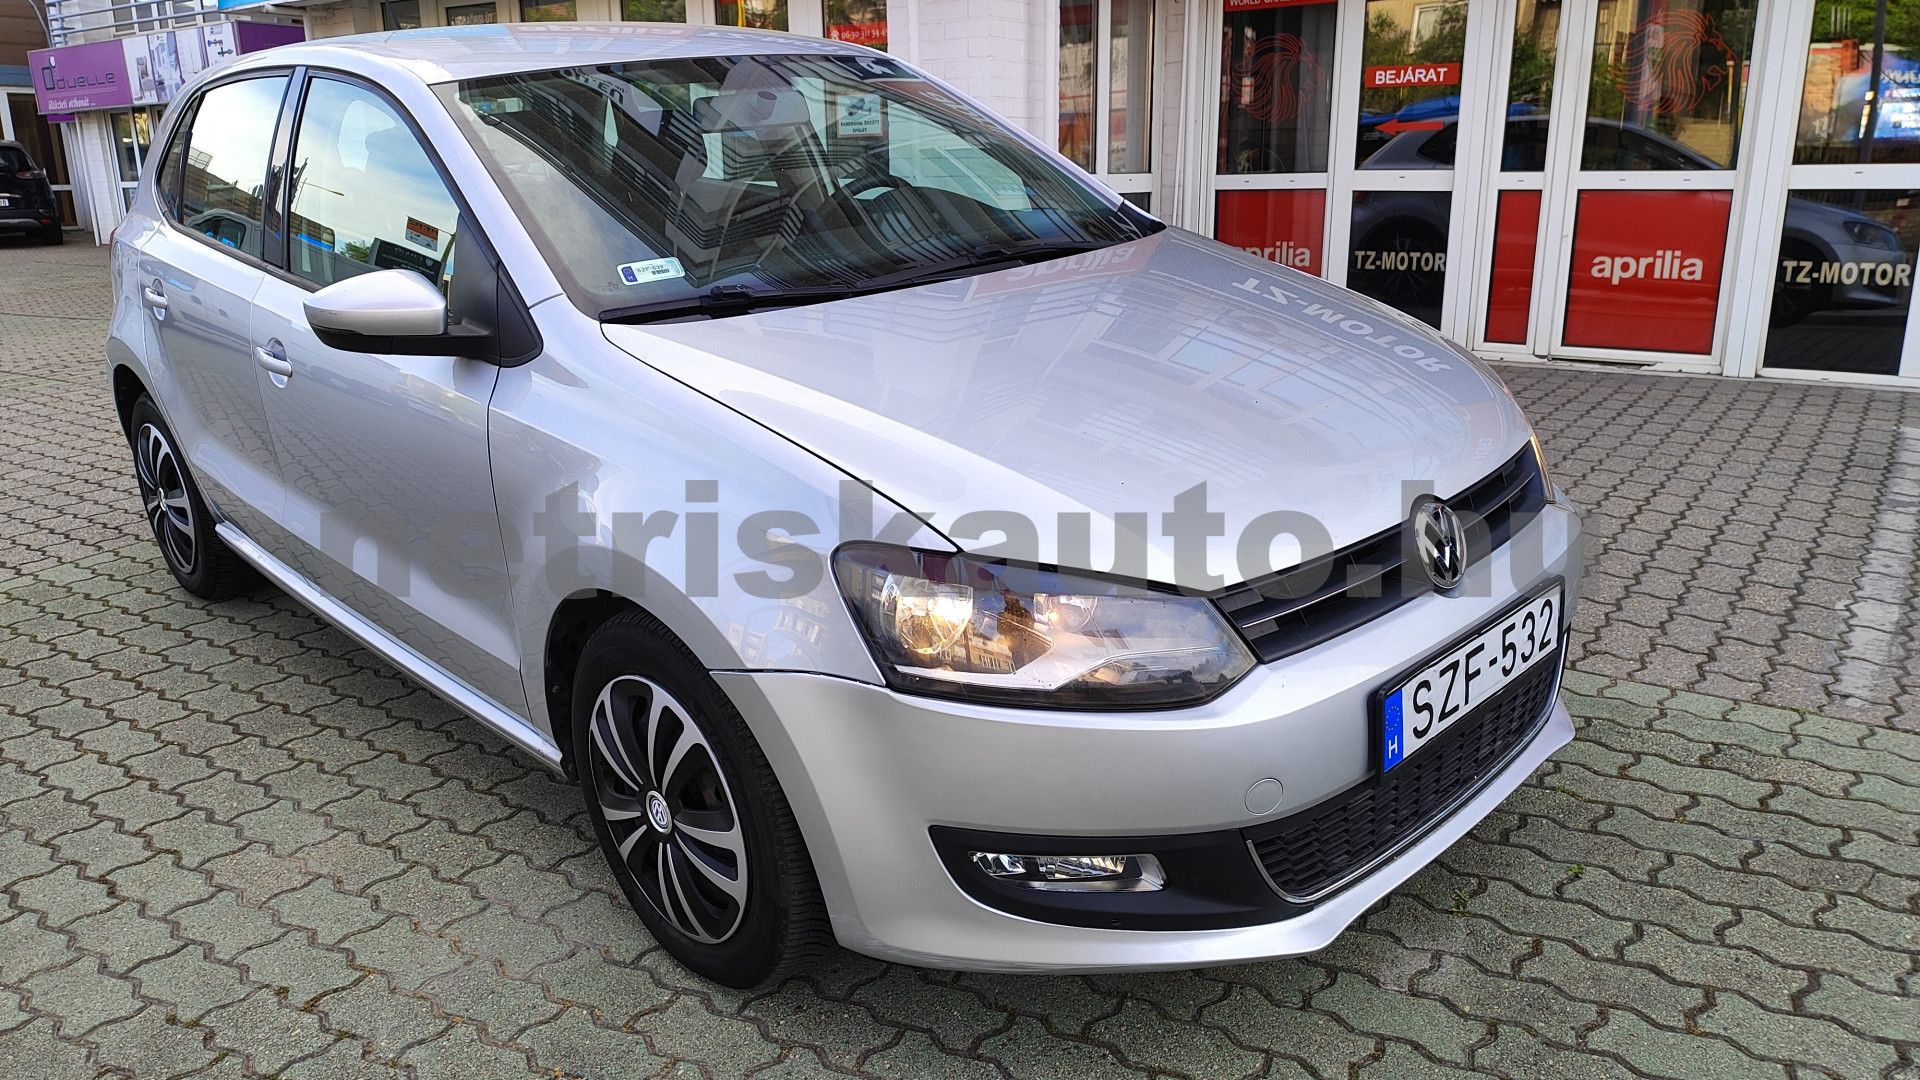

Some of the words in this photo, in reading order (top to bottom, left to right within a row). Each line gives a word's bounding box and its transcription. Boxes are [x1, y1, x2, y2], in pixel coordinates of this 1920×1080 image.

[841, 30, 850, 39] 06
[851, 31, 860, 40] 30
[871, 29, 880, 38] 34
[1375, 66, 1448, 84] BEJÁRAT
[1233, 241, 1311, 267] rilia
[1355, 250, 1446, 272] TZ-MOTOR
[1591, 250, 1704, 285] aprilia
[1783, 260, 1912, 287] TZ-MOTOR
[1412, 598, 1553, 740] SZF-532
[1388, 734, 1399, 760] H
